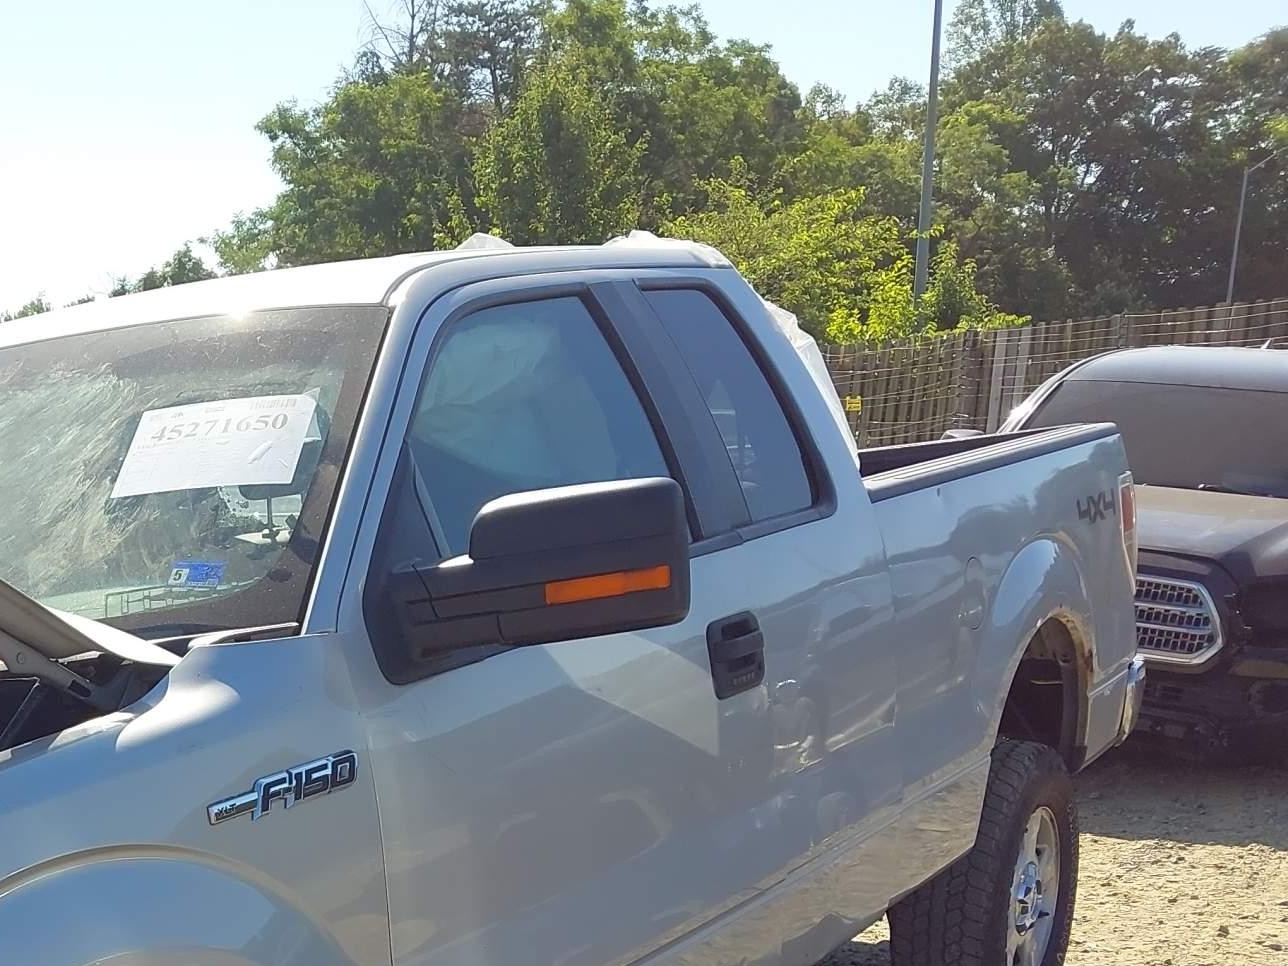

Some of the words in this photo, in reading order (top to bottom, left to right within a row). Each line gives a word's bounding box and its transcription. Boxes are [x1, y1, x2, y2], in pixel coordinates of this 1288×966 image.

[150, 413, 290, 442] 45271650
[1076, 488, 1116, 525] 4X4
[173, 570, 184, 582] 5
